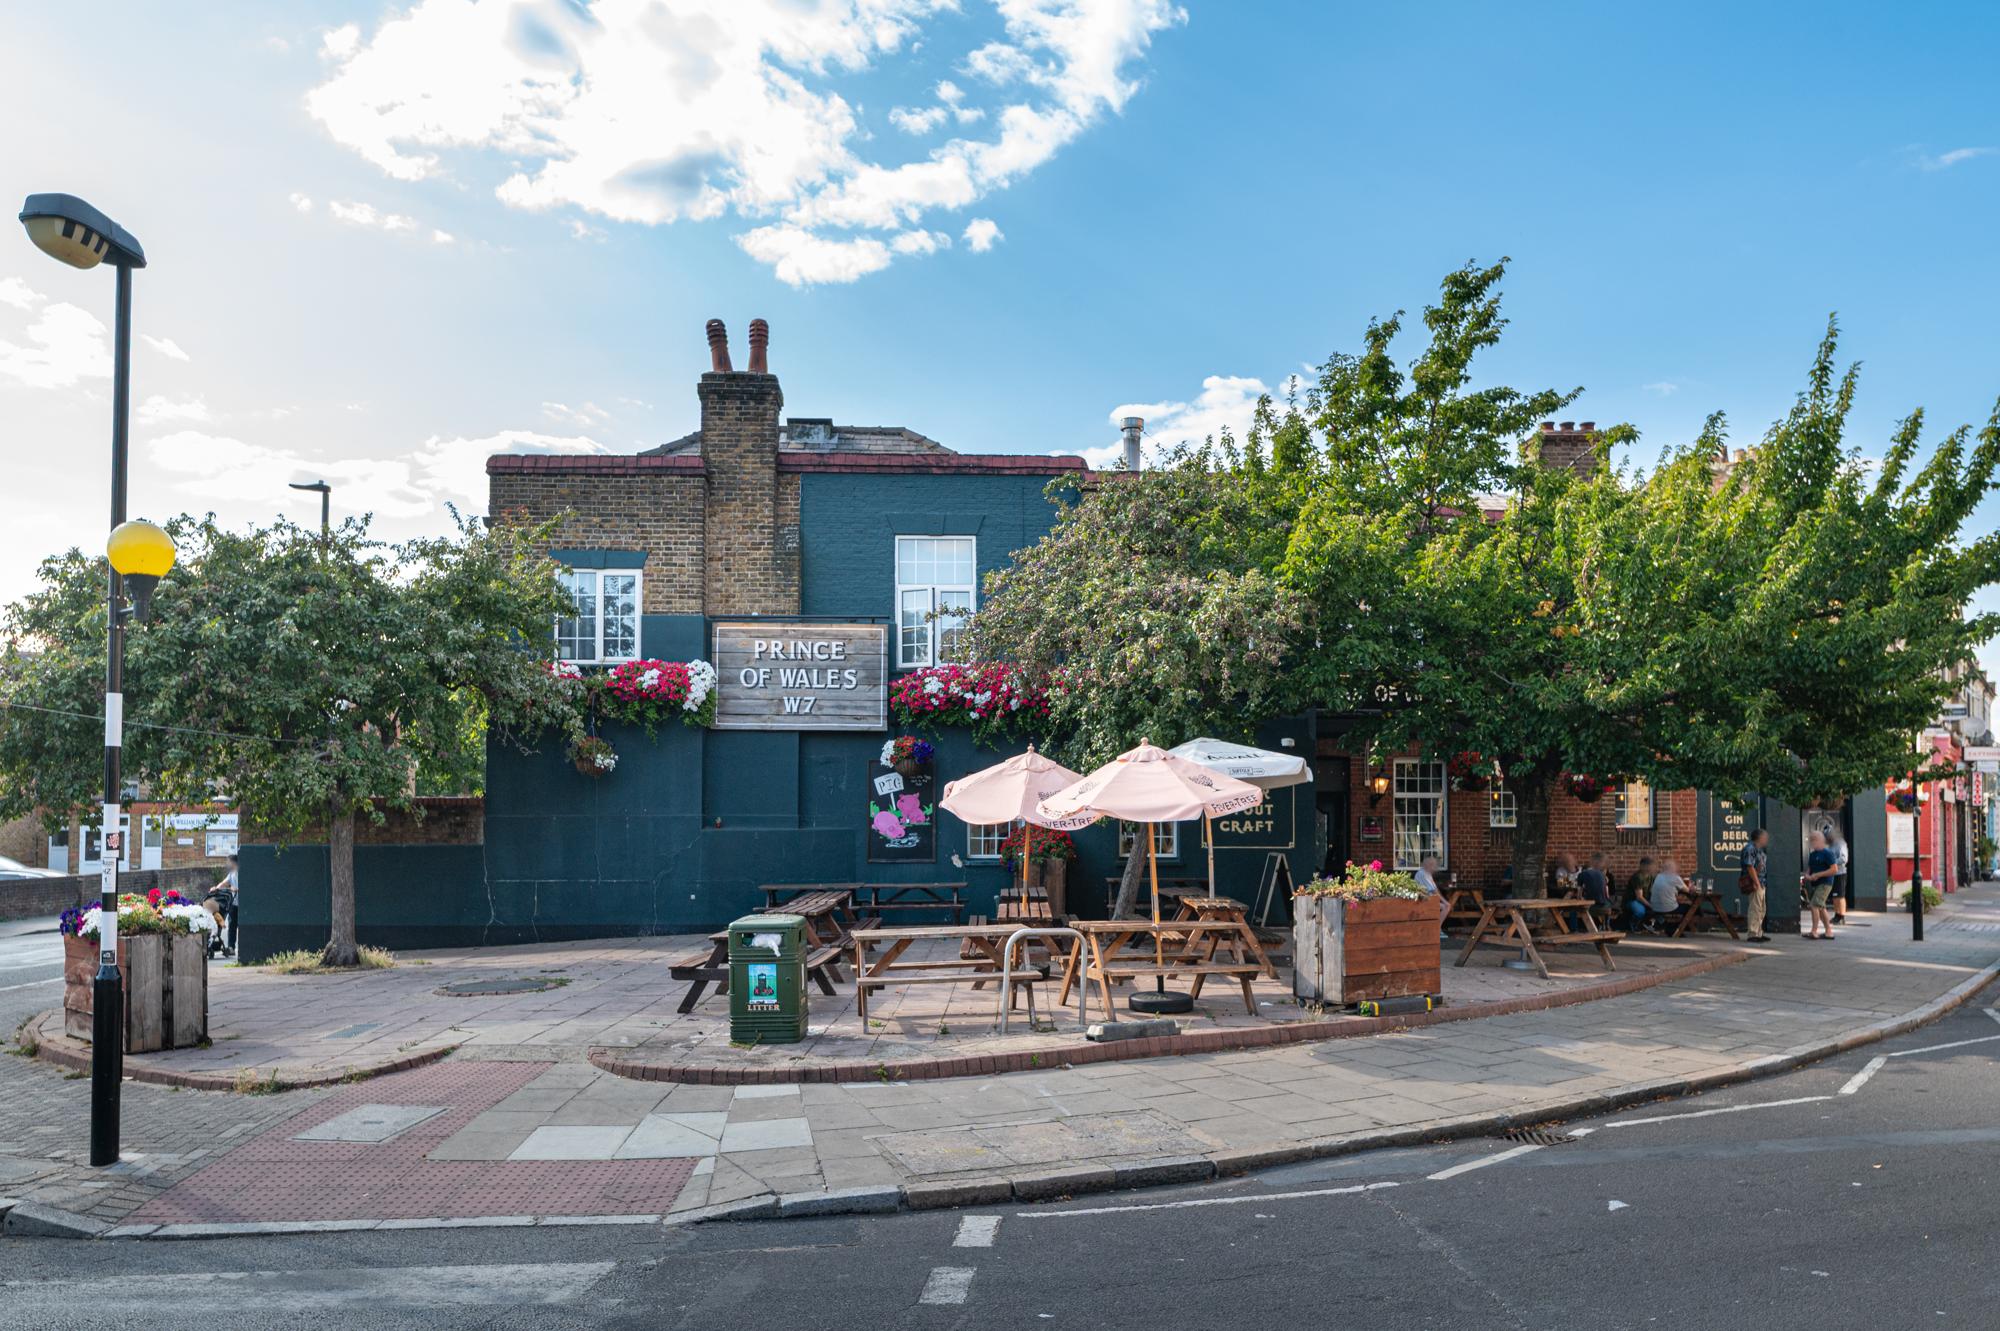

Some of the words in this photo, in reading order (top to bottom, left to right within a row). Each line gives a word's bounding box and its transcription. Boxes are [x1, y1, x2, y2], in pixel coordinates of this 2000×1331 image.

[754, 640, 846, 661] PRINCE
[740, 668, 772, 689] OF
[779, 668, 858, 690] WALES
[1375, 684, 1398, 702] OF
[783, 696, 818, 714] W7
[878, 777, 901, 793] PIG
[1211, 794, 1258, 813] FEVER-TREE
[1235, 804, 1274, 816] OUT
[176, 817, 195, 825] WILLIAM
[1220, 820, 1274, 834] CRAFT
[1725, 815, 1743, 824] GIN
[1722, 831, 1749, 840] BEER
[1714, 842, 1748, 851] GARD
